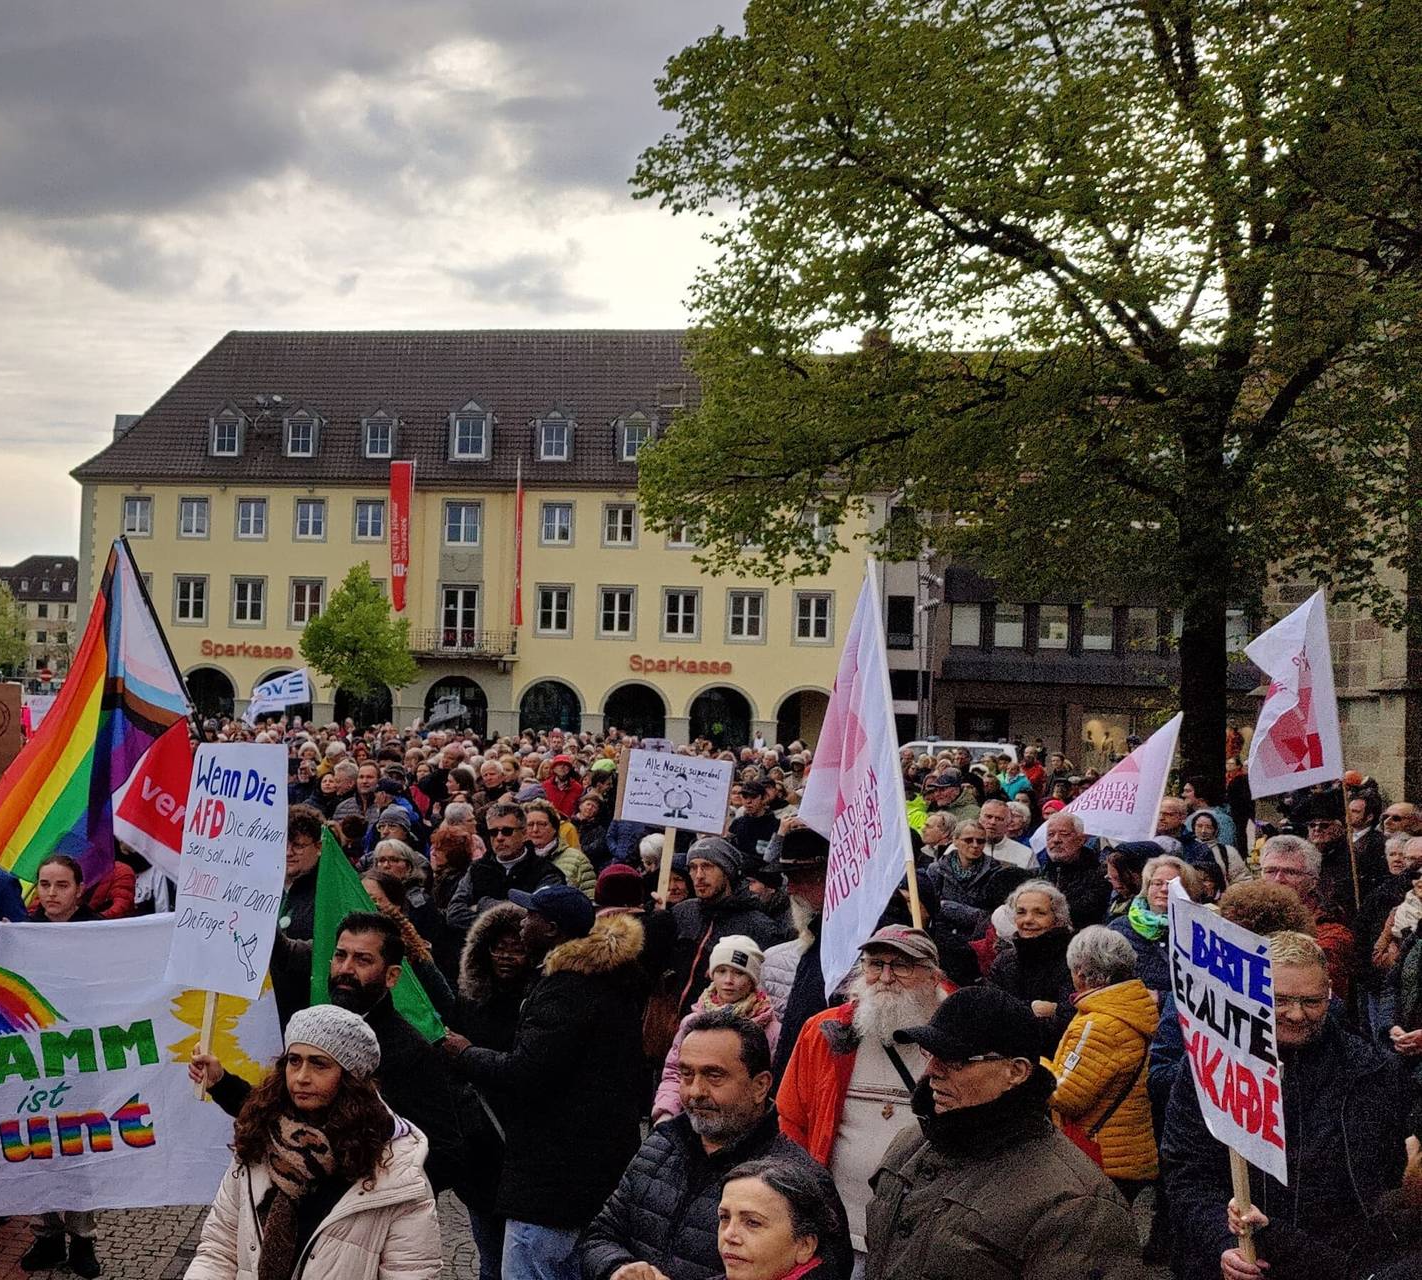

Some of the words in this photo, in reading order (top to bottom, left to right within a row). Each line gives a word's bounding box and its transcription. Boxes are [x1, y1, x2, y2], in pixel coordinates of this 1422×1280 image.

[201, 639, 294, 659] Sparkasse
[629, 654, 732, 676] Sparkasse
[644, 757, 660, 771] Alle
[195, 755, 241, 798] Wenn
[243, 769, 277, 807] Die
[188, 796, 226, 840] AFD
[16, 1079, 72, 1114] ist
